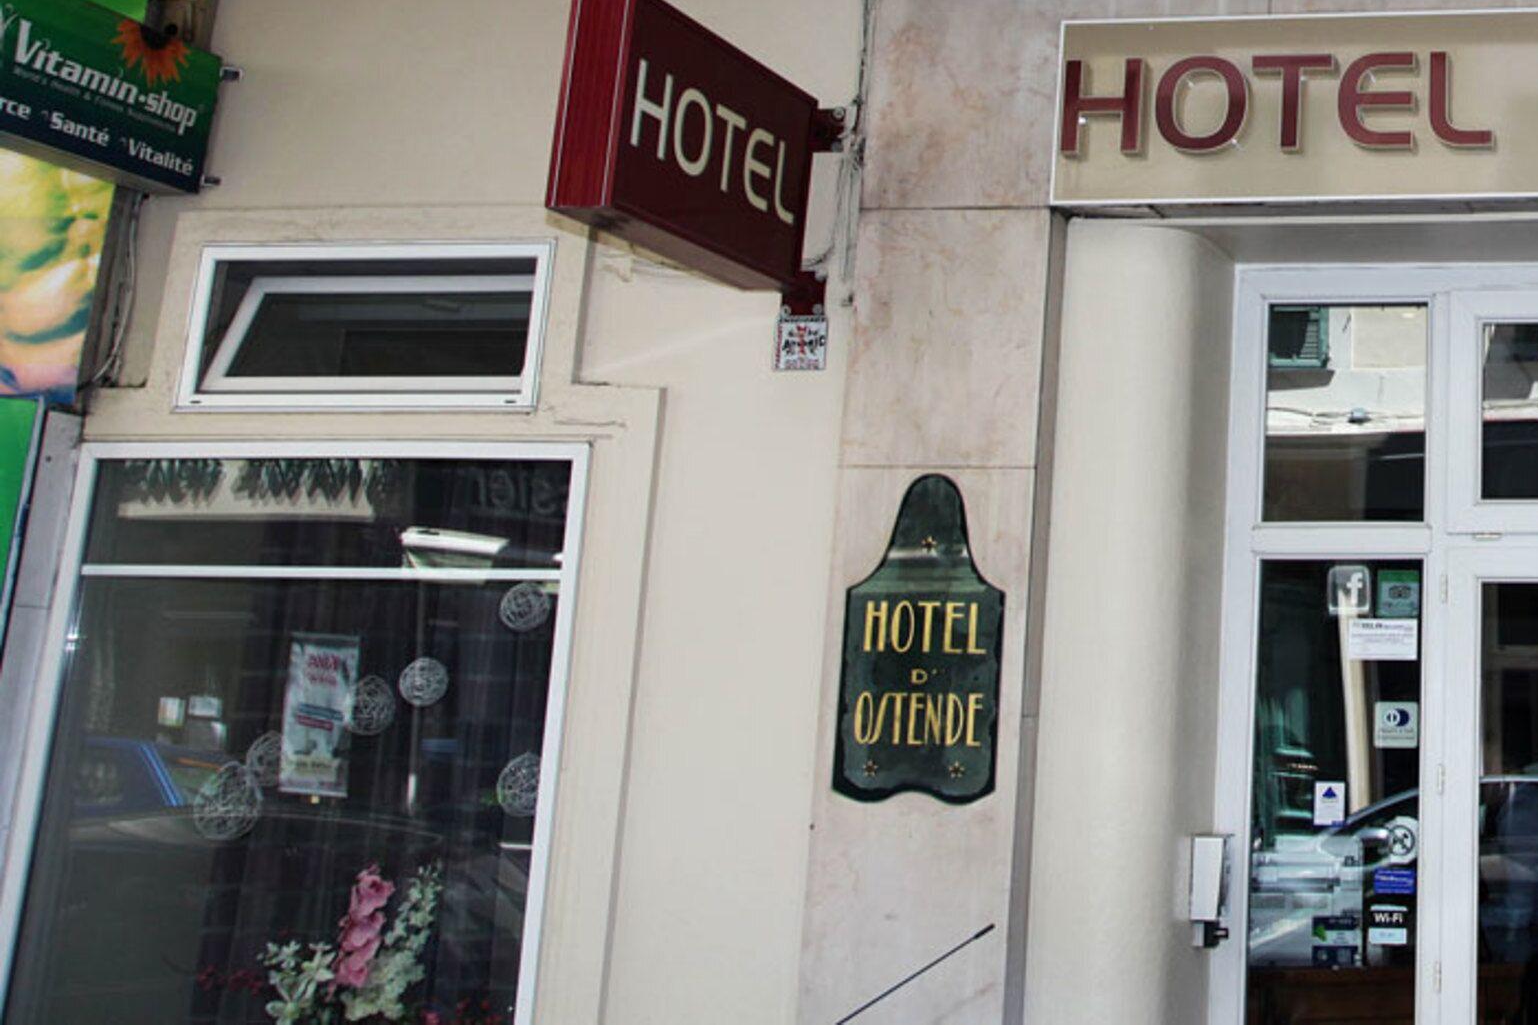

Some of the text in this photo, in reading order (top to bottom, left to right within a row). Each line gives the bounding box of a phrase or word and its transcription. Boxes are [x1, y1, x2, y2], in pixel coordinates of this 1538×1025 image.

[1060, 51, 1494, 156] HOTEL
[51, 111, 110, 147] Santé
[128, 137, 193, 176] Vitalité
[630, 58, 794, 224] HOTEL
[862, 599, 987, 654] HOTEL
[911, 667, 937, 685] D'
[854, 691, 985, 748] OSTENDE
[1373, 912, 1403, 923] Wi-Fi
